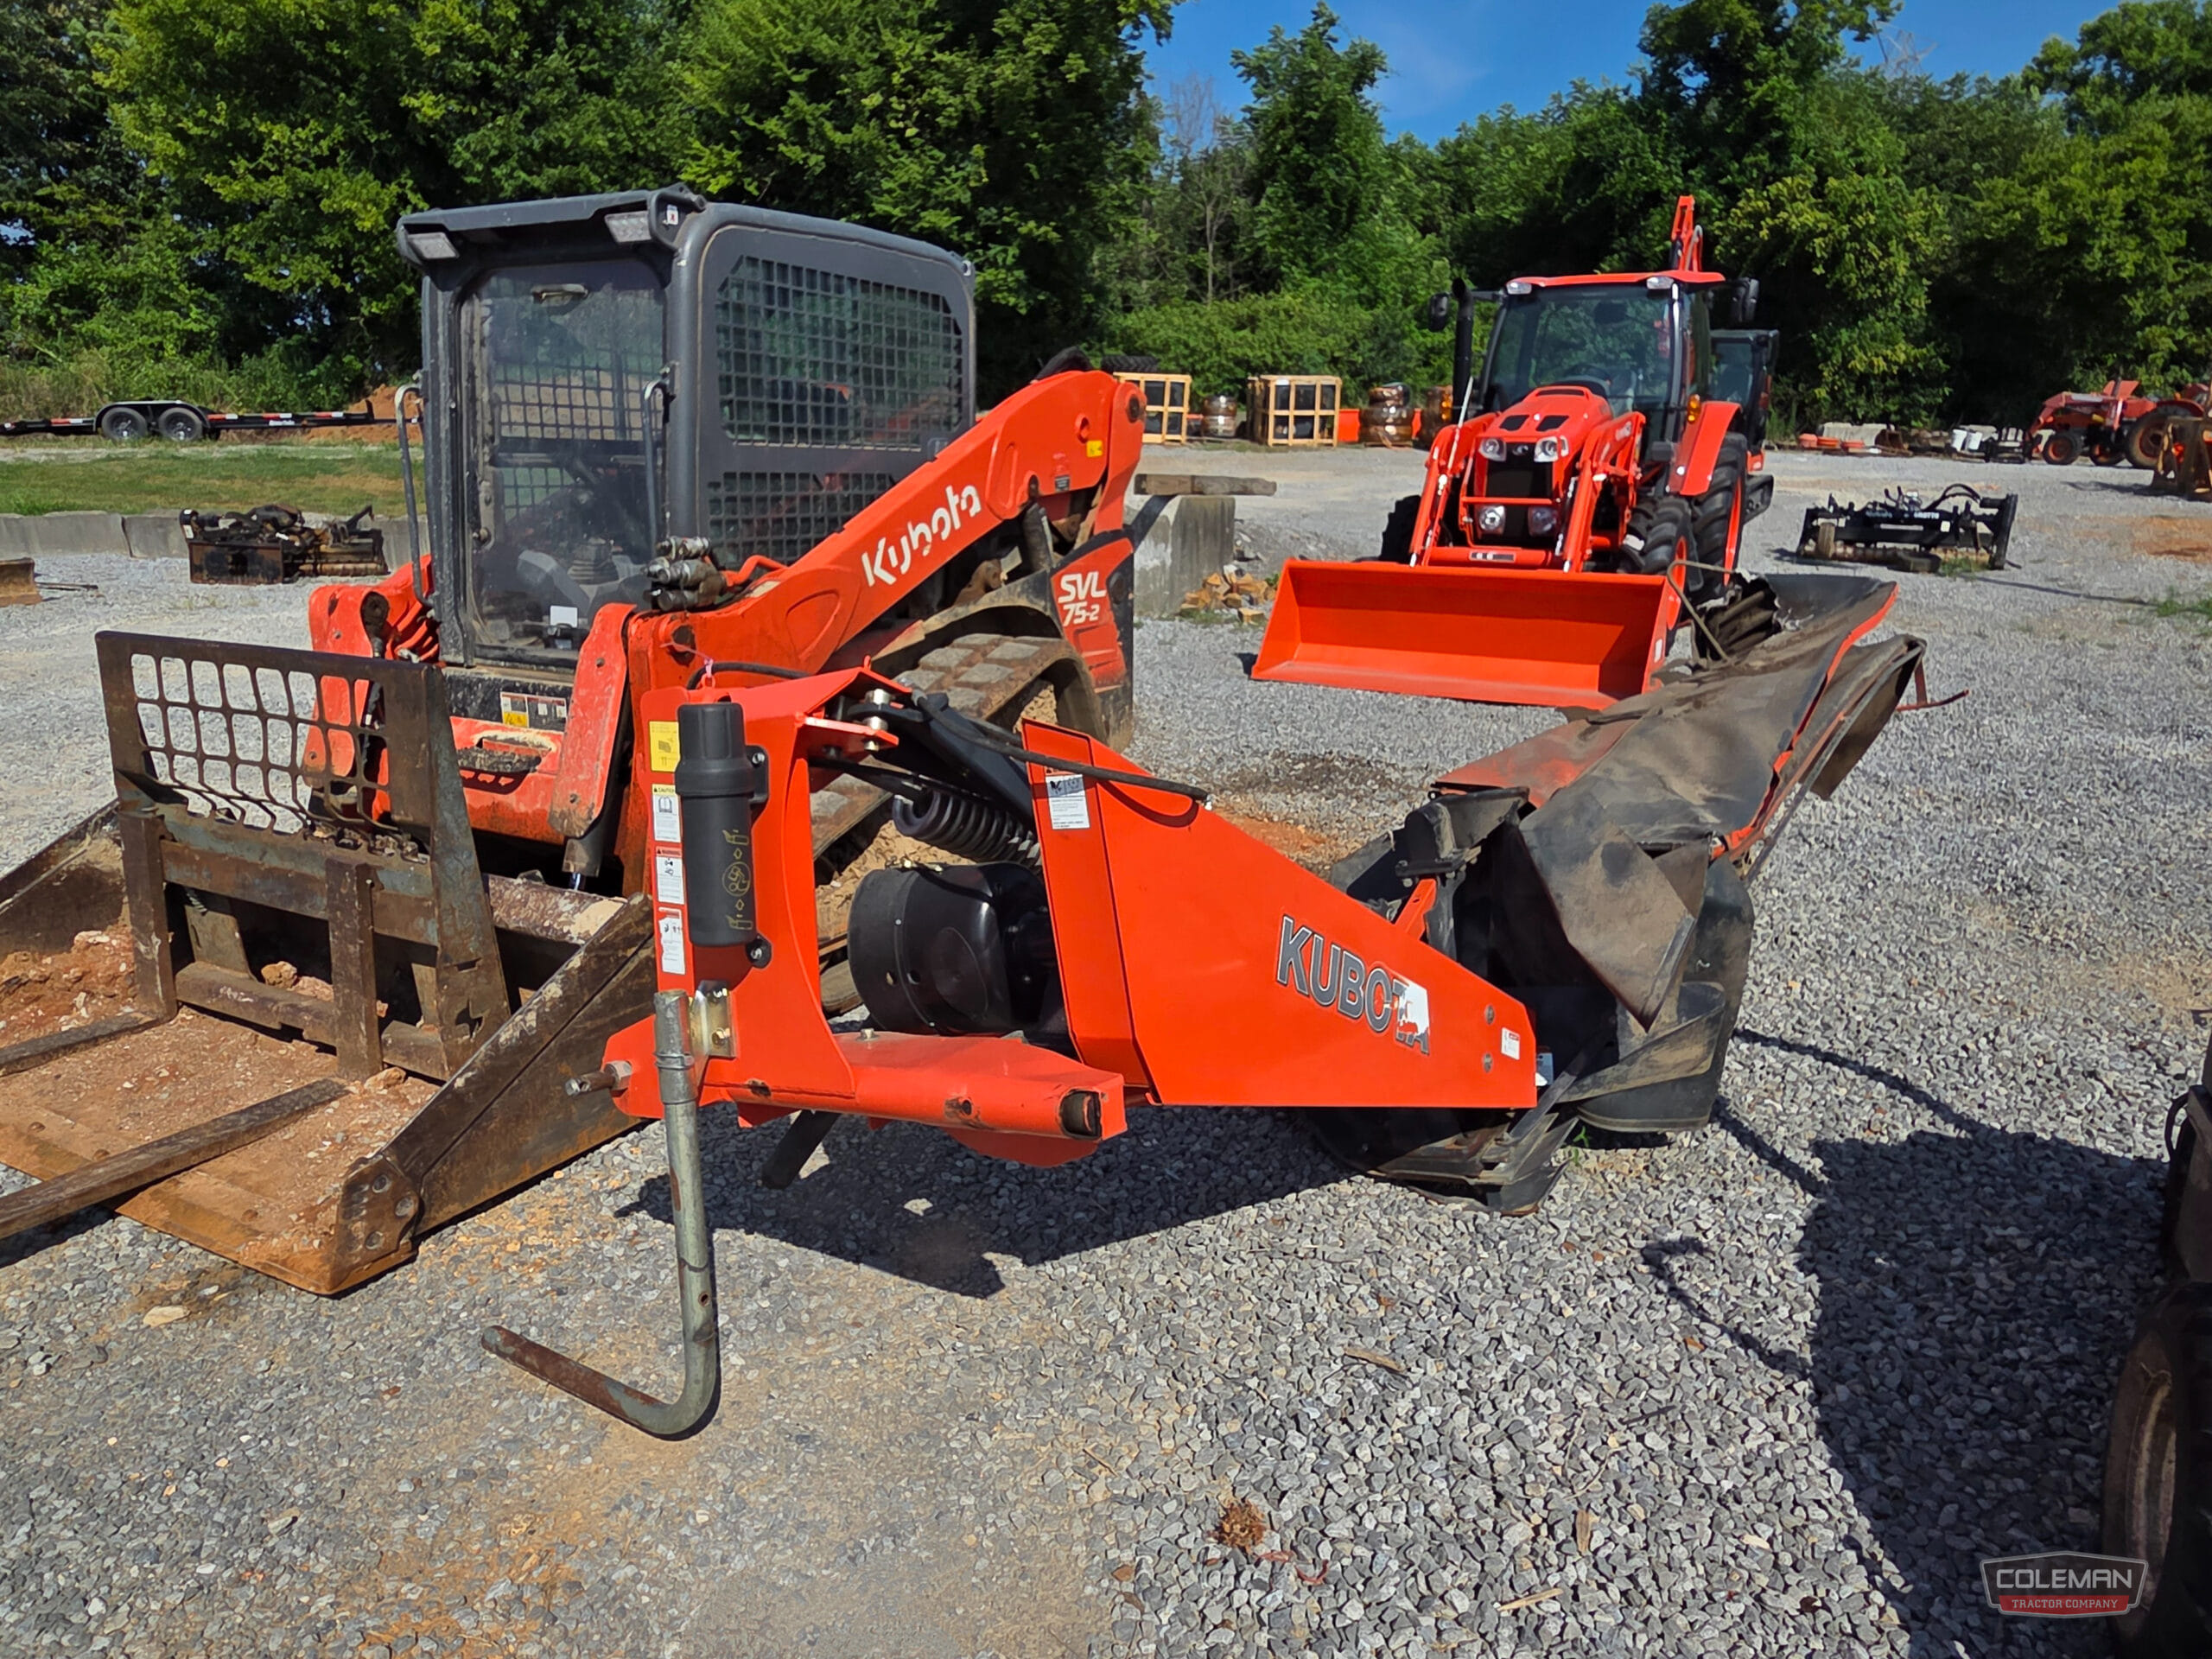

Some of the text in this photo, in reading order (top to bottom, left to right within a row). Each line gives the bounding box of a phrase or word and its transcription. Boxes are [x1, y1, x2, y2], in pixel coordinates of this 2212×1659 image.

[861, 485, 982, 588] Kubota
[1058, 571, 1107, 604] SVL
[1063, 601, 1100, 627] 75-2
